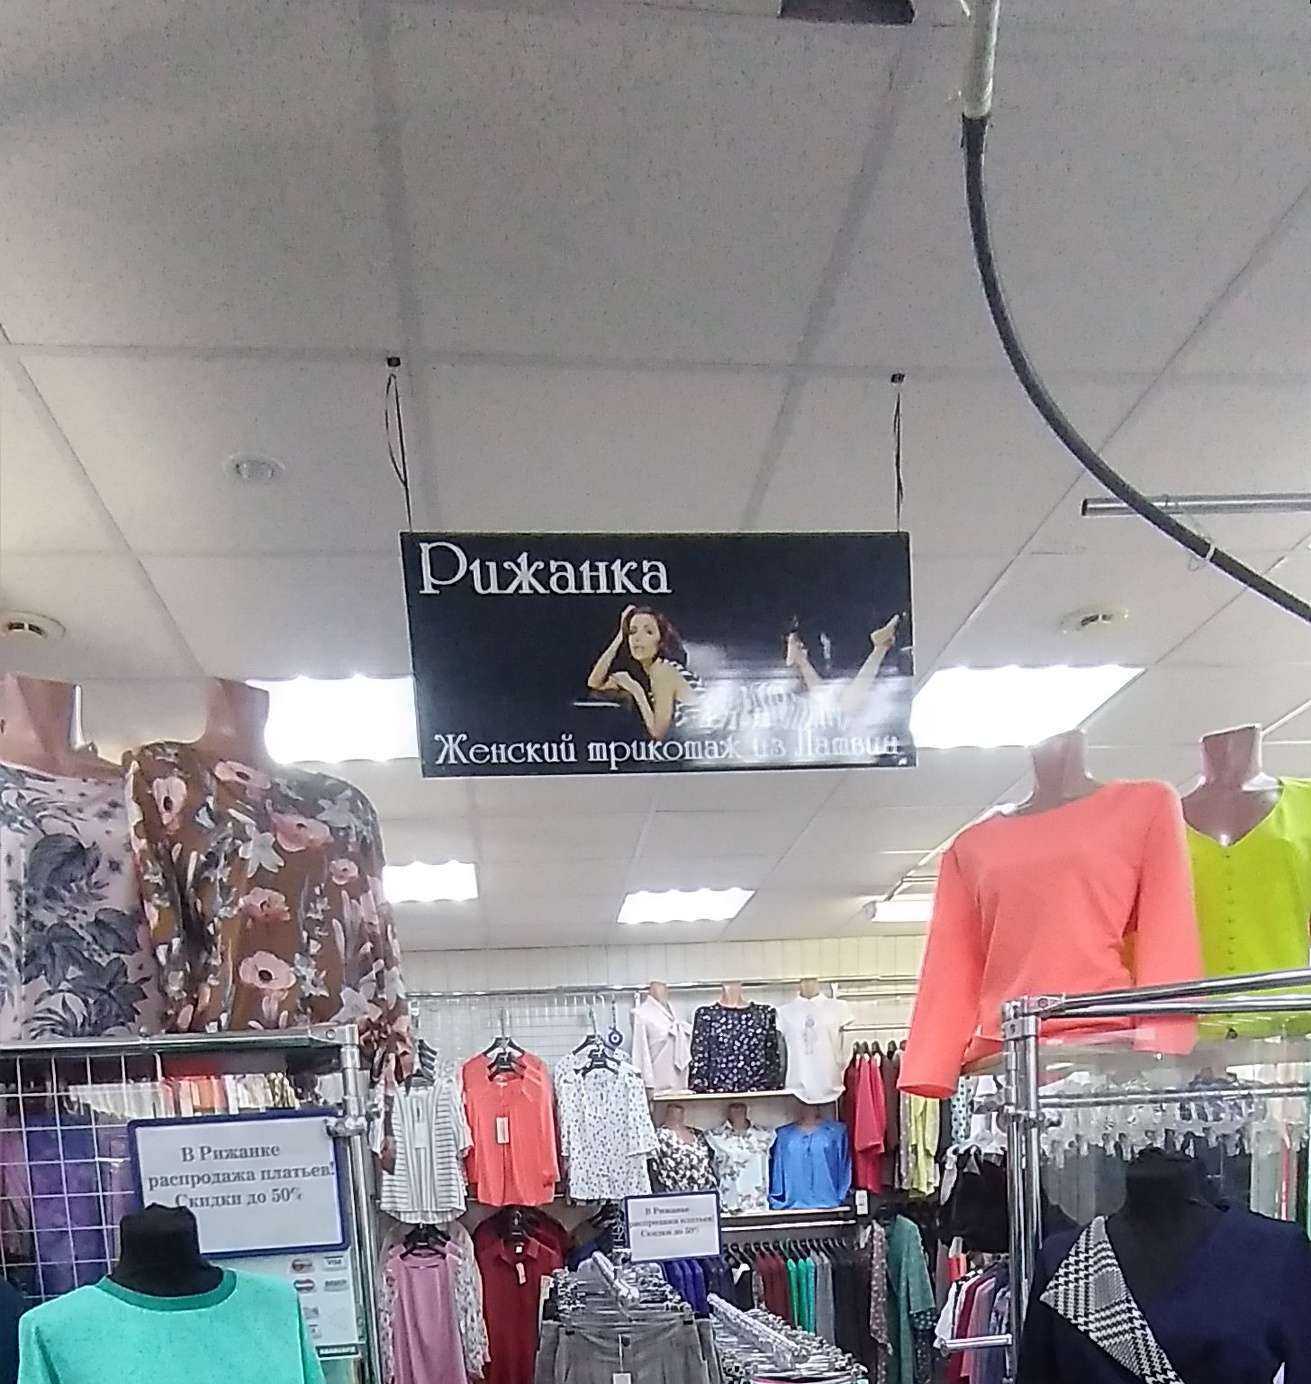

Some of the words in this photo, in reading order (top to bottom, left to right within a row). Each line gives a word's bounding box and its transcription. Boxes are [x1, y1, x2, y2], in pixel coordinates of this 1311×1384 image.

[418, 541, 672, 595] Рижанка
[434, 733, 578, 765] Женский
[586, 734, 742, 771] трикотаж
[752, 737, 787, 758] из
[181, 1146, 196, 1163] В
[199, 1143, 281, 1162] Рижанке
[148, 1170, 256, 1192] распродажа
[260, 1161, 336, 1182] платьев!
[175, 1191, 243, 1209] Скидки
[246, 1192, 267, 1207] до
